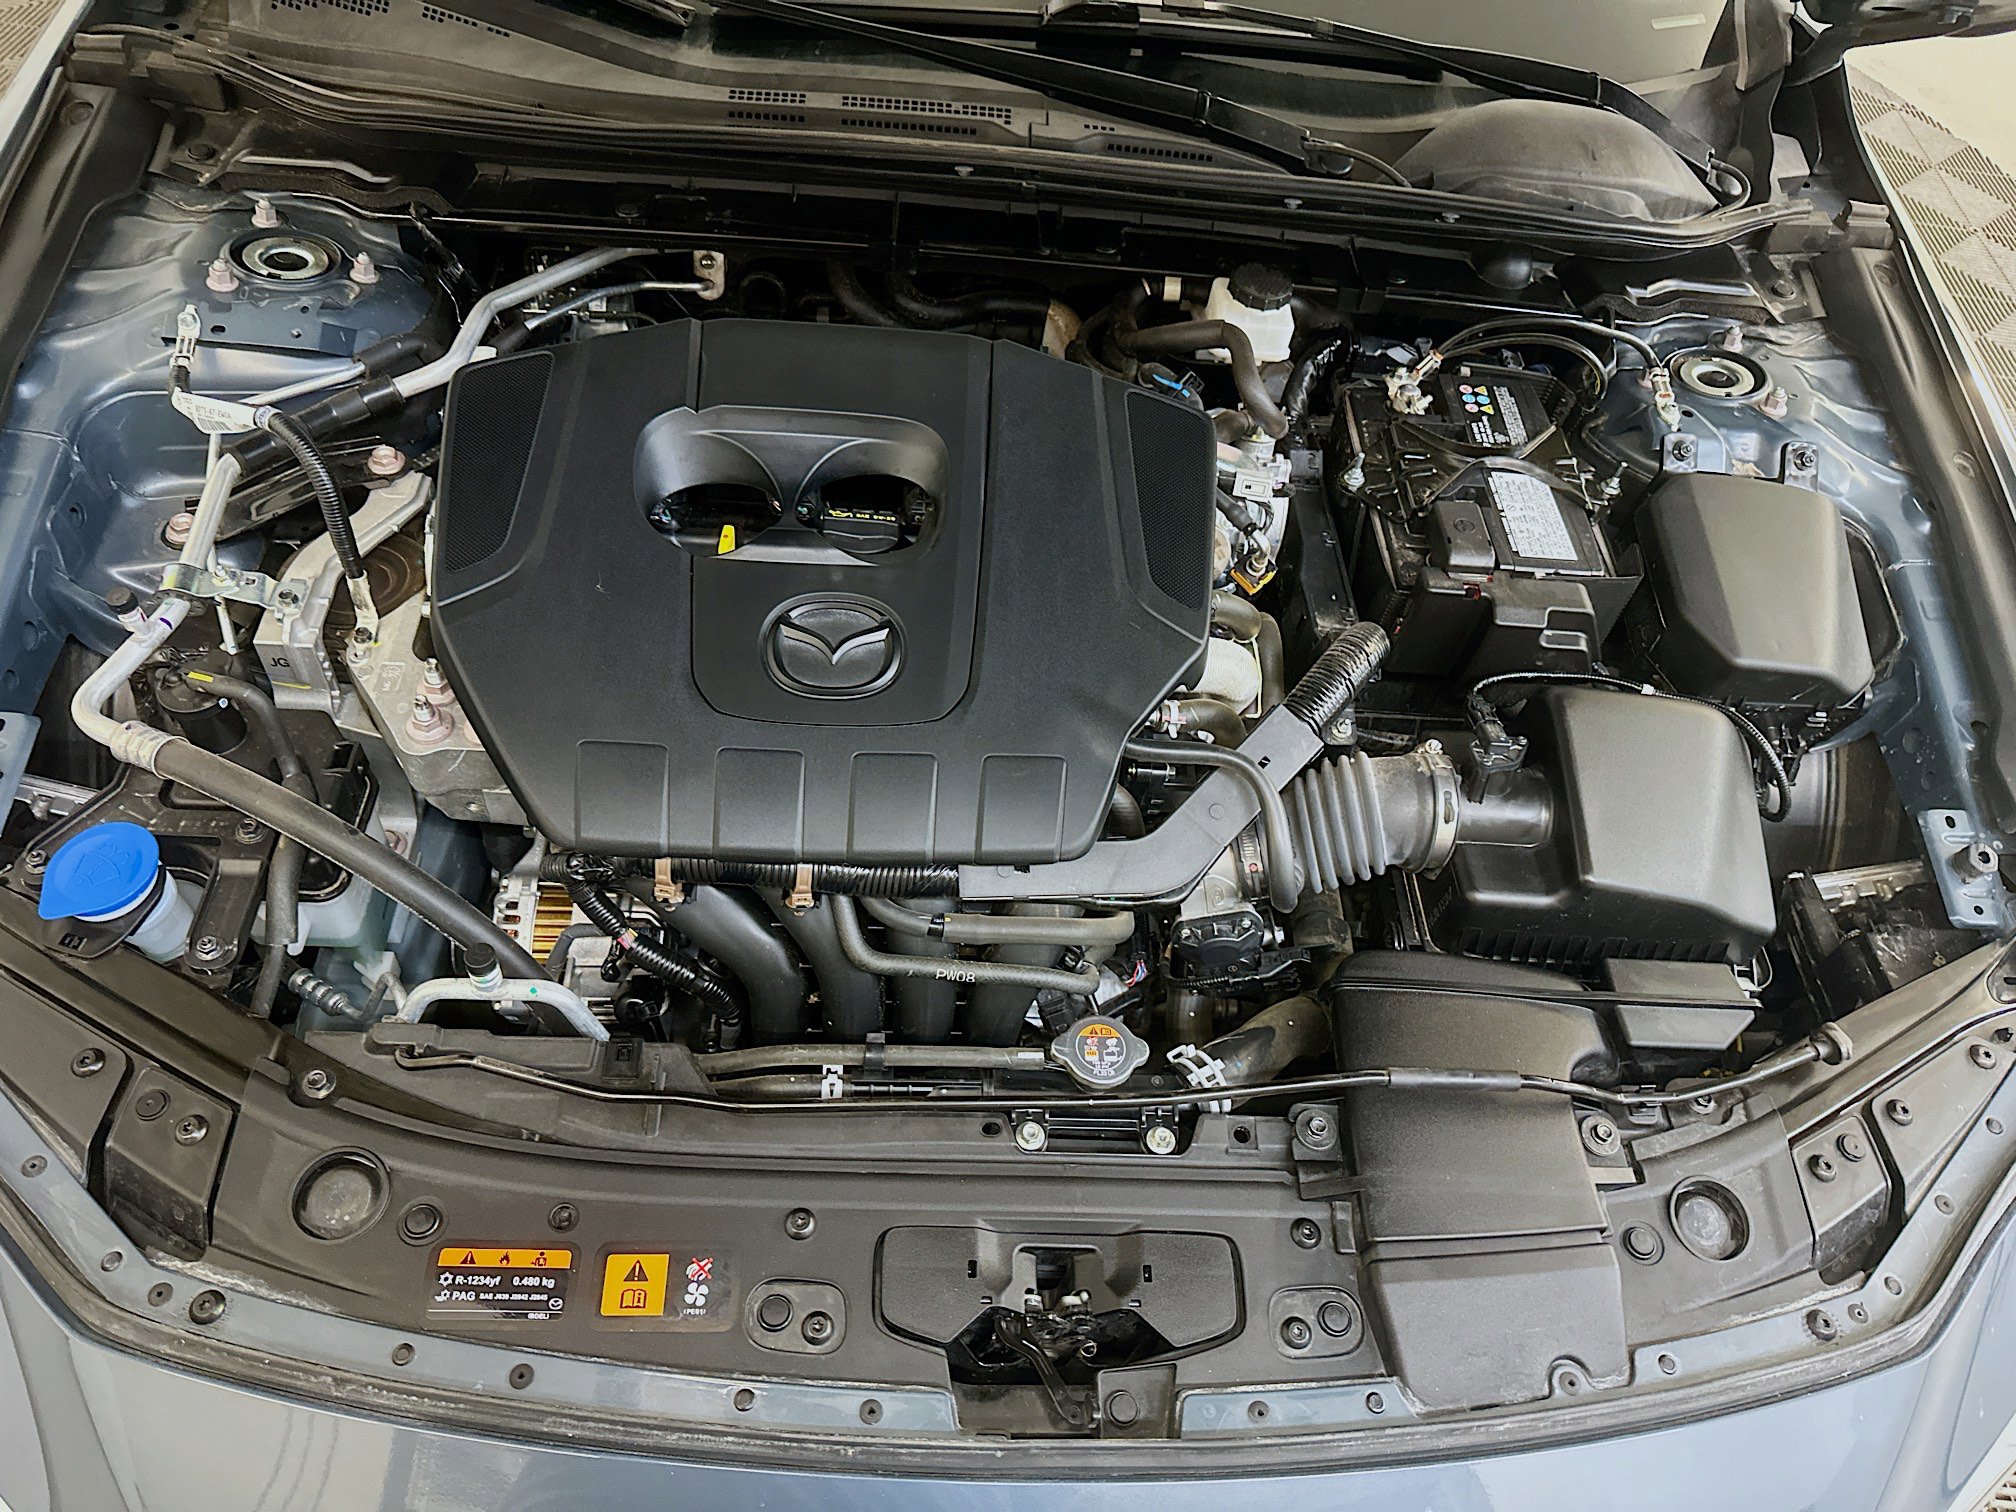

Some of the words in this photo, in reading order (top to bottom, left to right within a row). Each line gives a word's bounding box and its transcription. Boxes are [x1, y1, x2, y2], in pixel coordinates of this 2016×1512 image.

[270, 657, 290, 667] JG
[935, 968, 976, 983] PW08
[454, 1275, 502, 1288] R-1234yf
[512, 1276, 541, 1287] 0.480
[541, 1276, 556, 1289] kg
[451, 1290, 476, 1301] PAG
